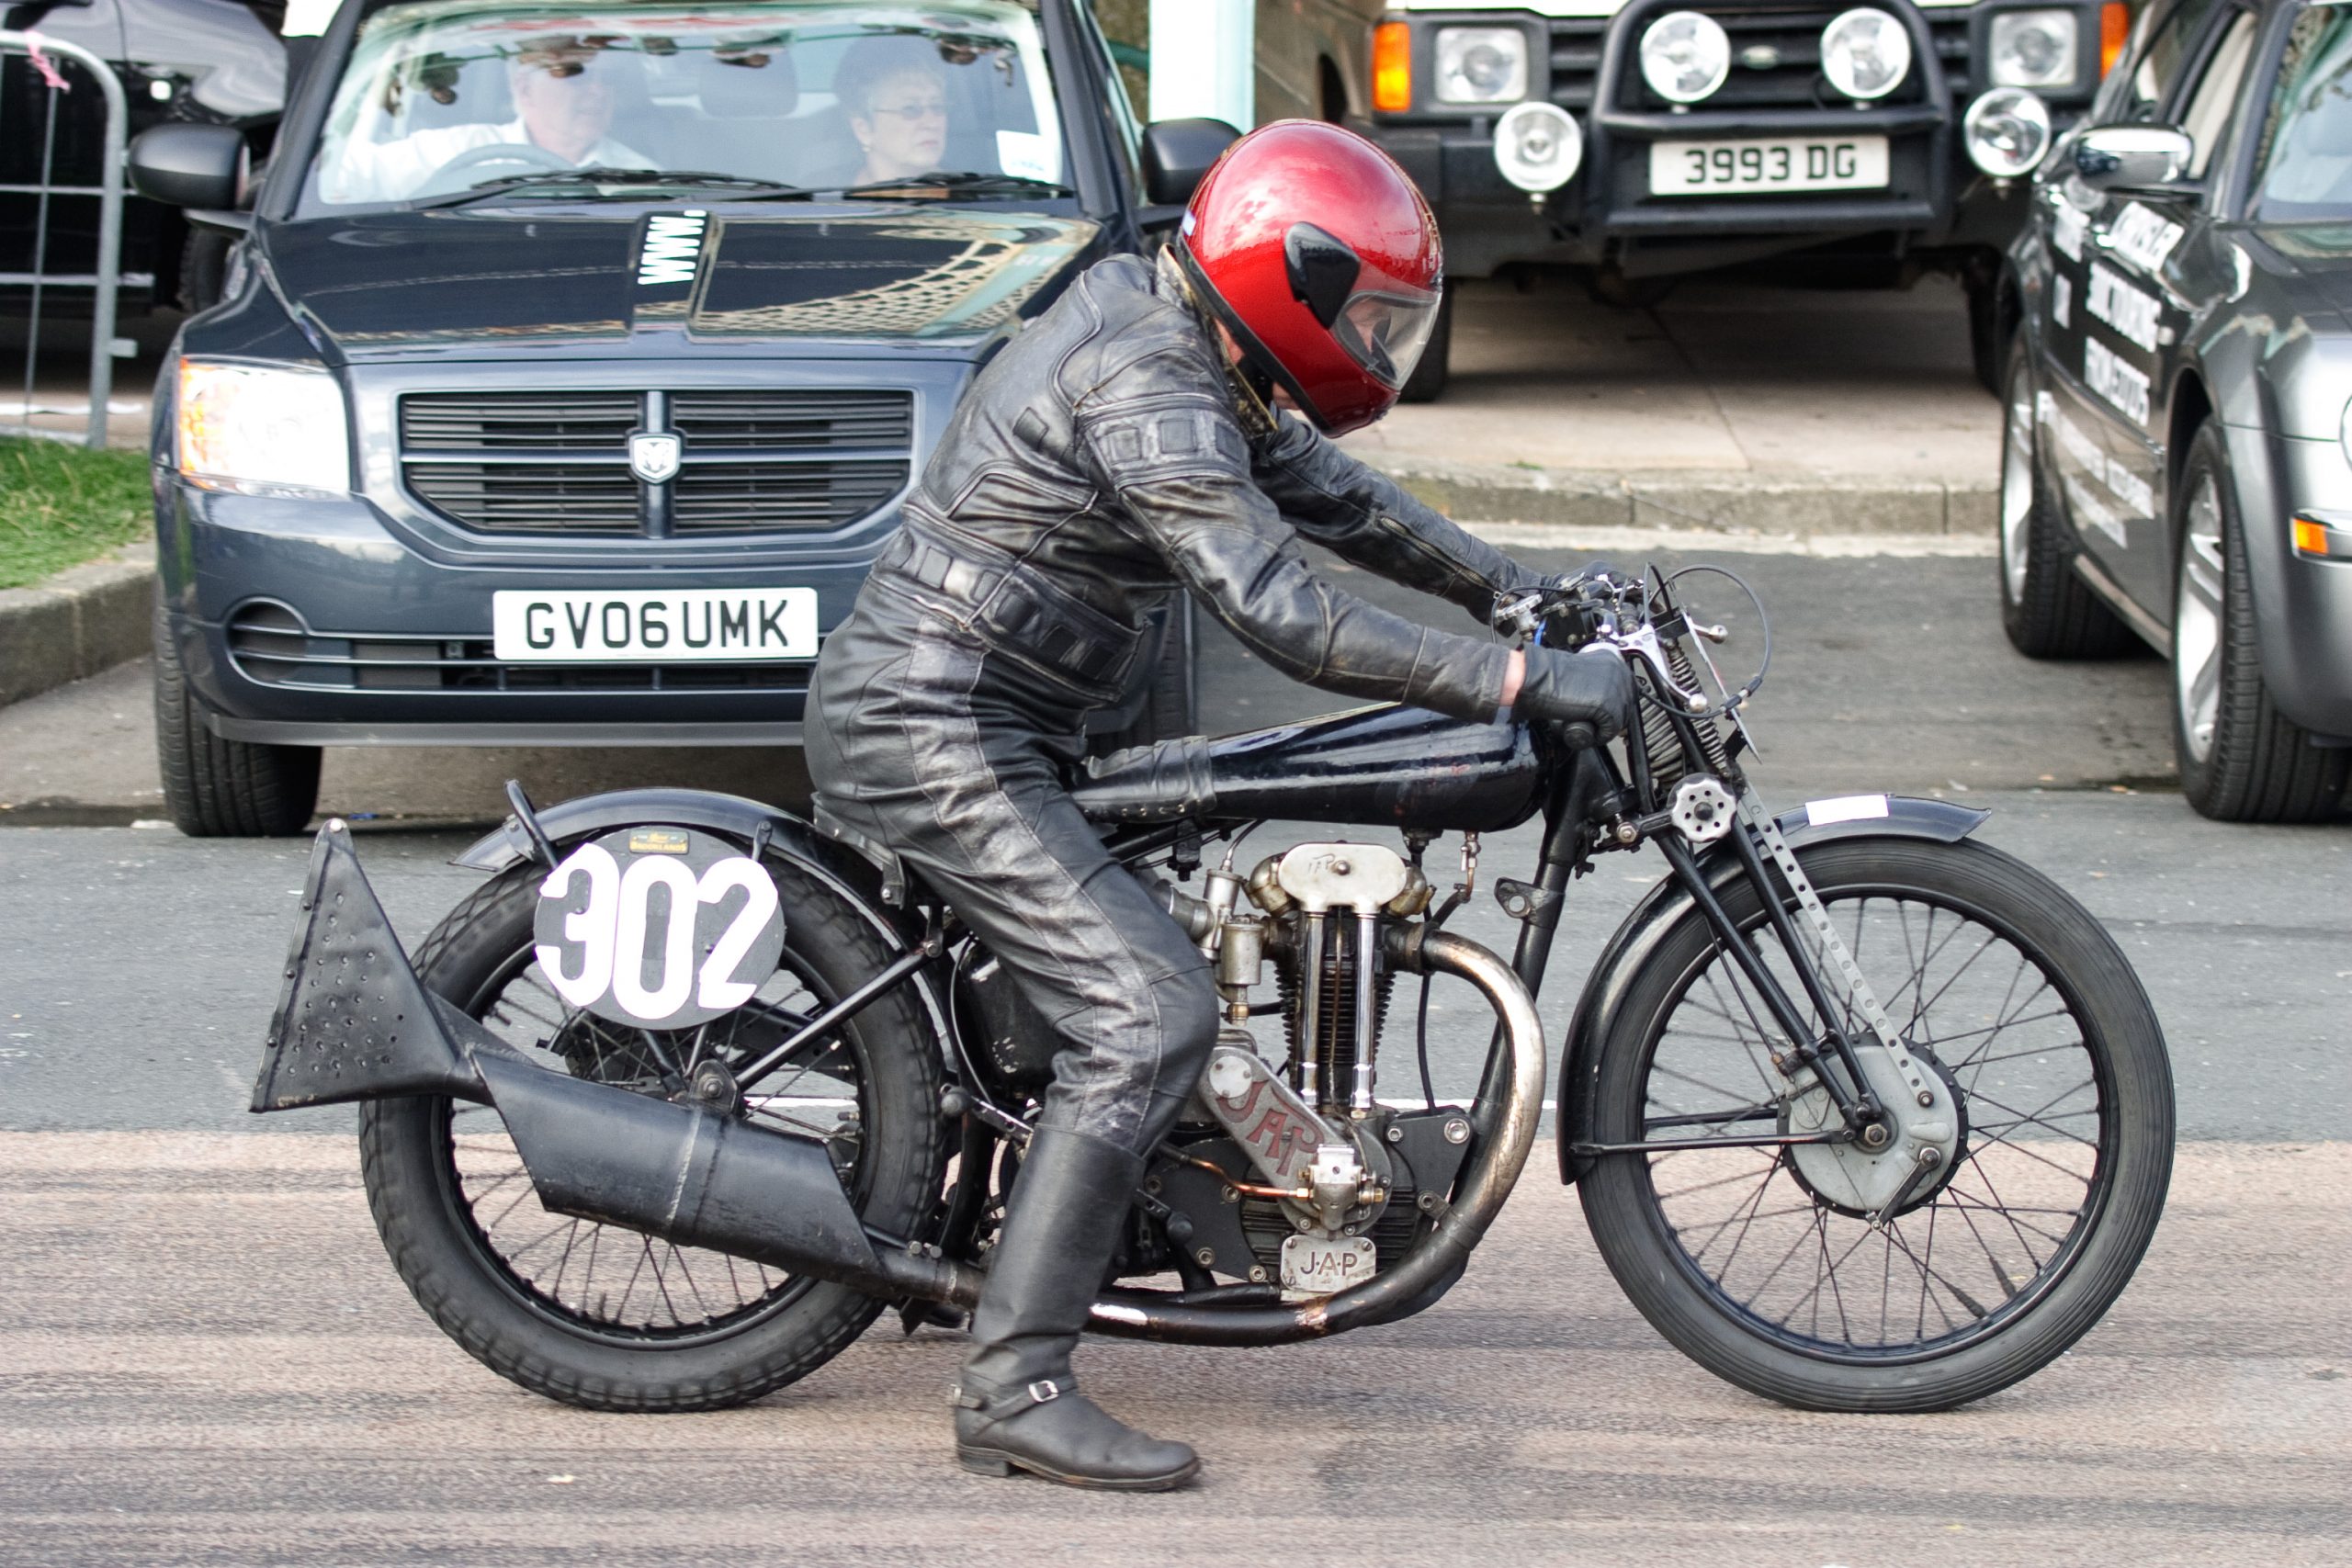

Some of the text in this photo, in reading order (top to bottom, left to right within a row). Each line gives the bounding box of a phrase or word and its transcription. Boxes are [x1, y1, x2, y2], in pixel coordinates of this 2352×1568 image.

[1686, 144, 1856, 184] 3993 DG
[526, 600, 788, 649] GV06UMK
[535, 842, 778, 1020] 302
[1216, 1079, 1325, 1177] JAP
